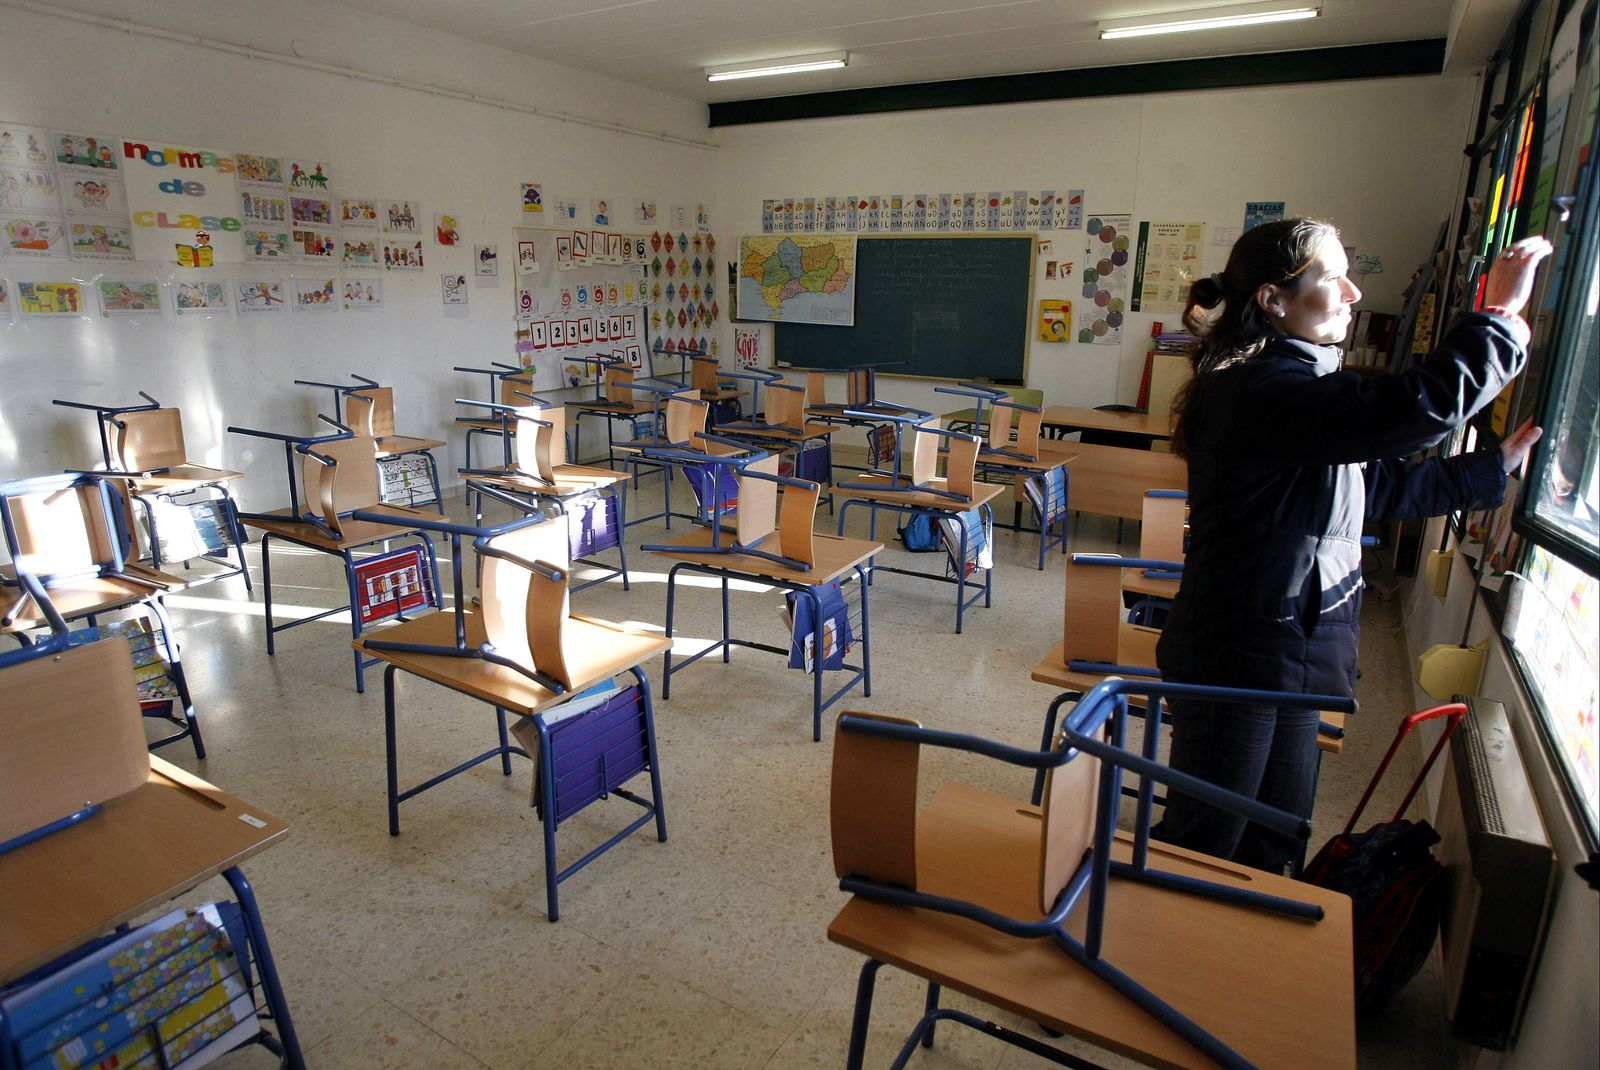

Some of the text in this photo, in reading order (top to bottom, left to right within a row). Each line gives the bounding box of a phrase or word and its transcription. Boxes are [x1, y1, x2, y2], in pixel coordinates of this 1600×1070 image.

[123, 141, 235, 173] normas
[159, 179, 206, 197] de
[537, 321, 632, 340] 1 2 3 4 5 6 7
[631, 351, 637, 362] 8
[737, 337, 759, 361] LOVE
